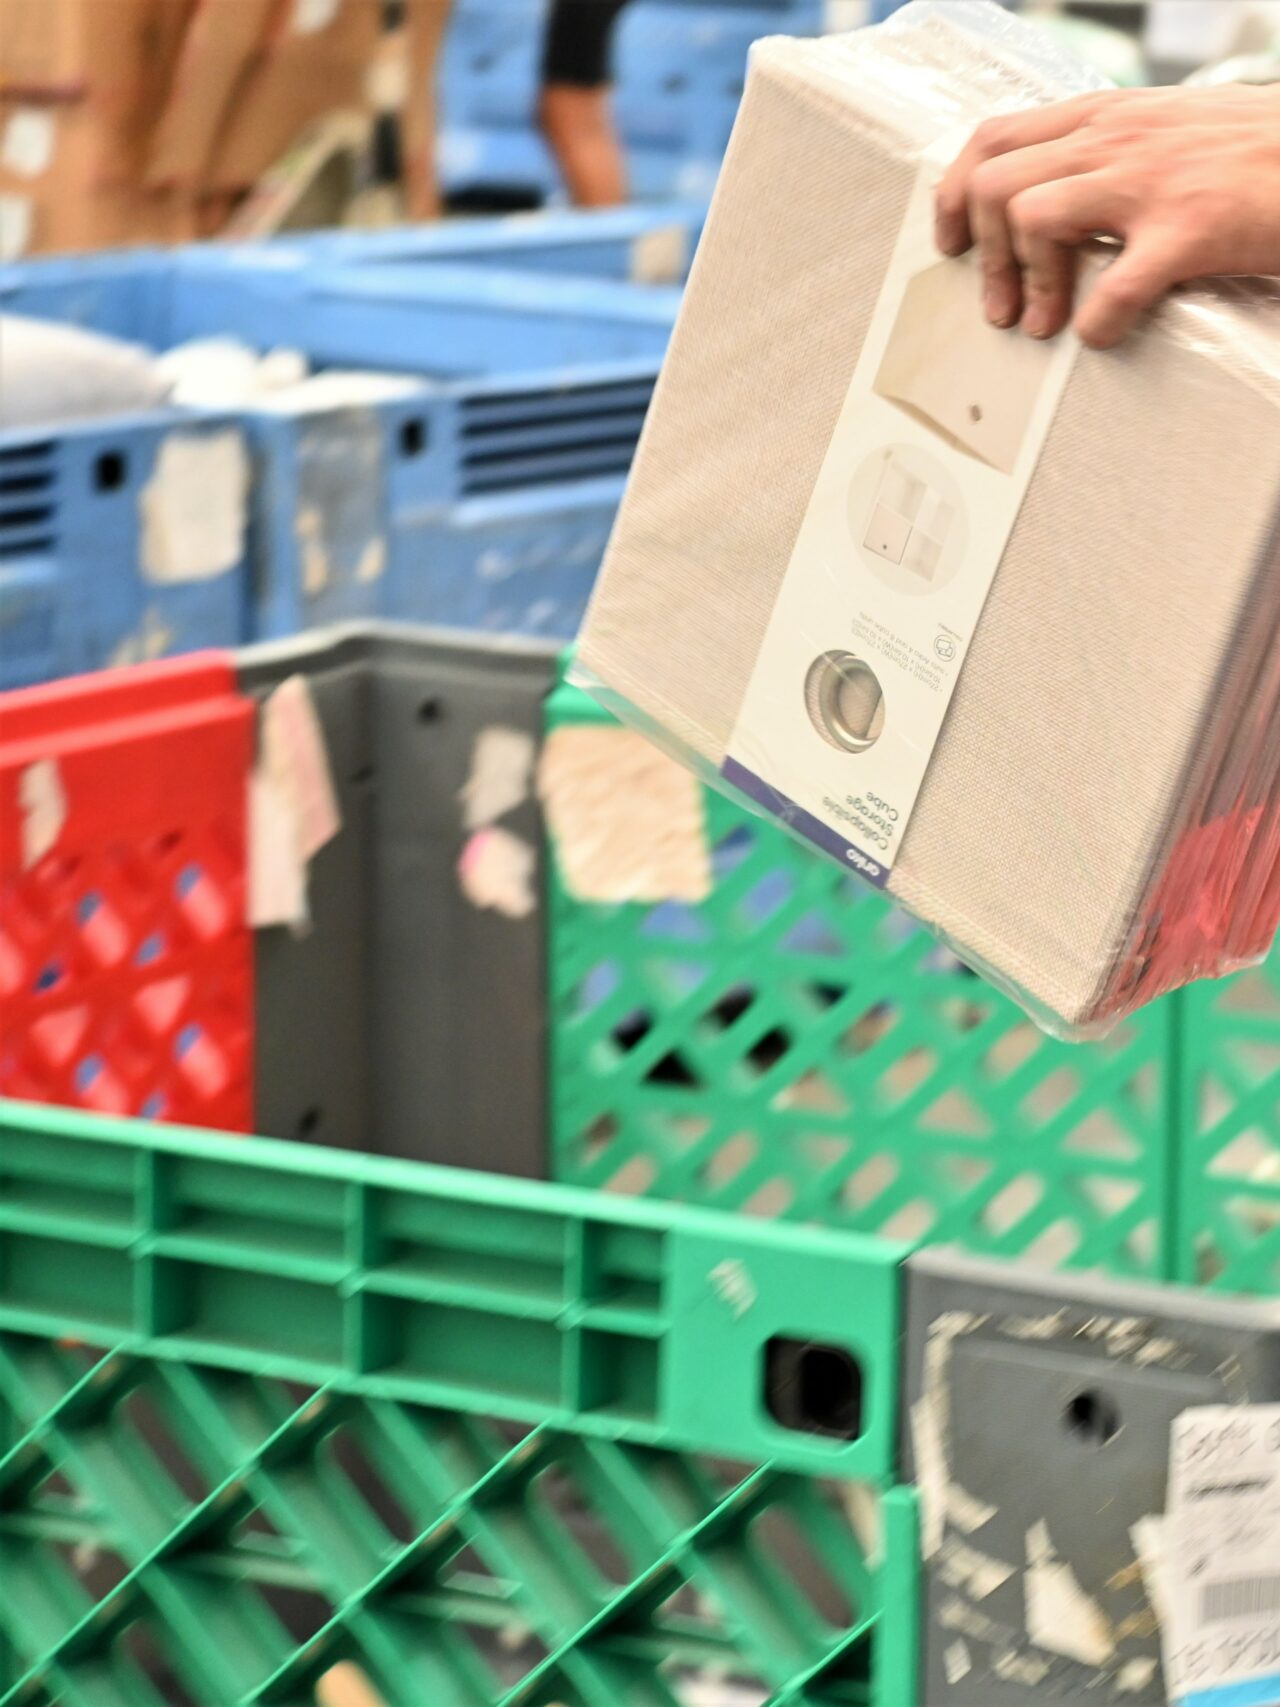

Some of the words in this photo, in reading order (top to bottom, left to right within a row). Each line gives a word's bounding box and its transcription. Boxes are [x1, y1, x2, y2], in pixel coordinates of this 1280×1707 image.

[823, 796, 889, 850] Collapsible
[846, 795, 894, 836] Storage
[866, 792, 898, 821] Cube
